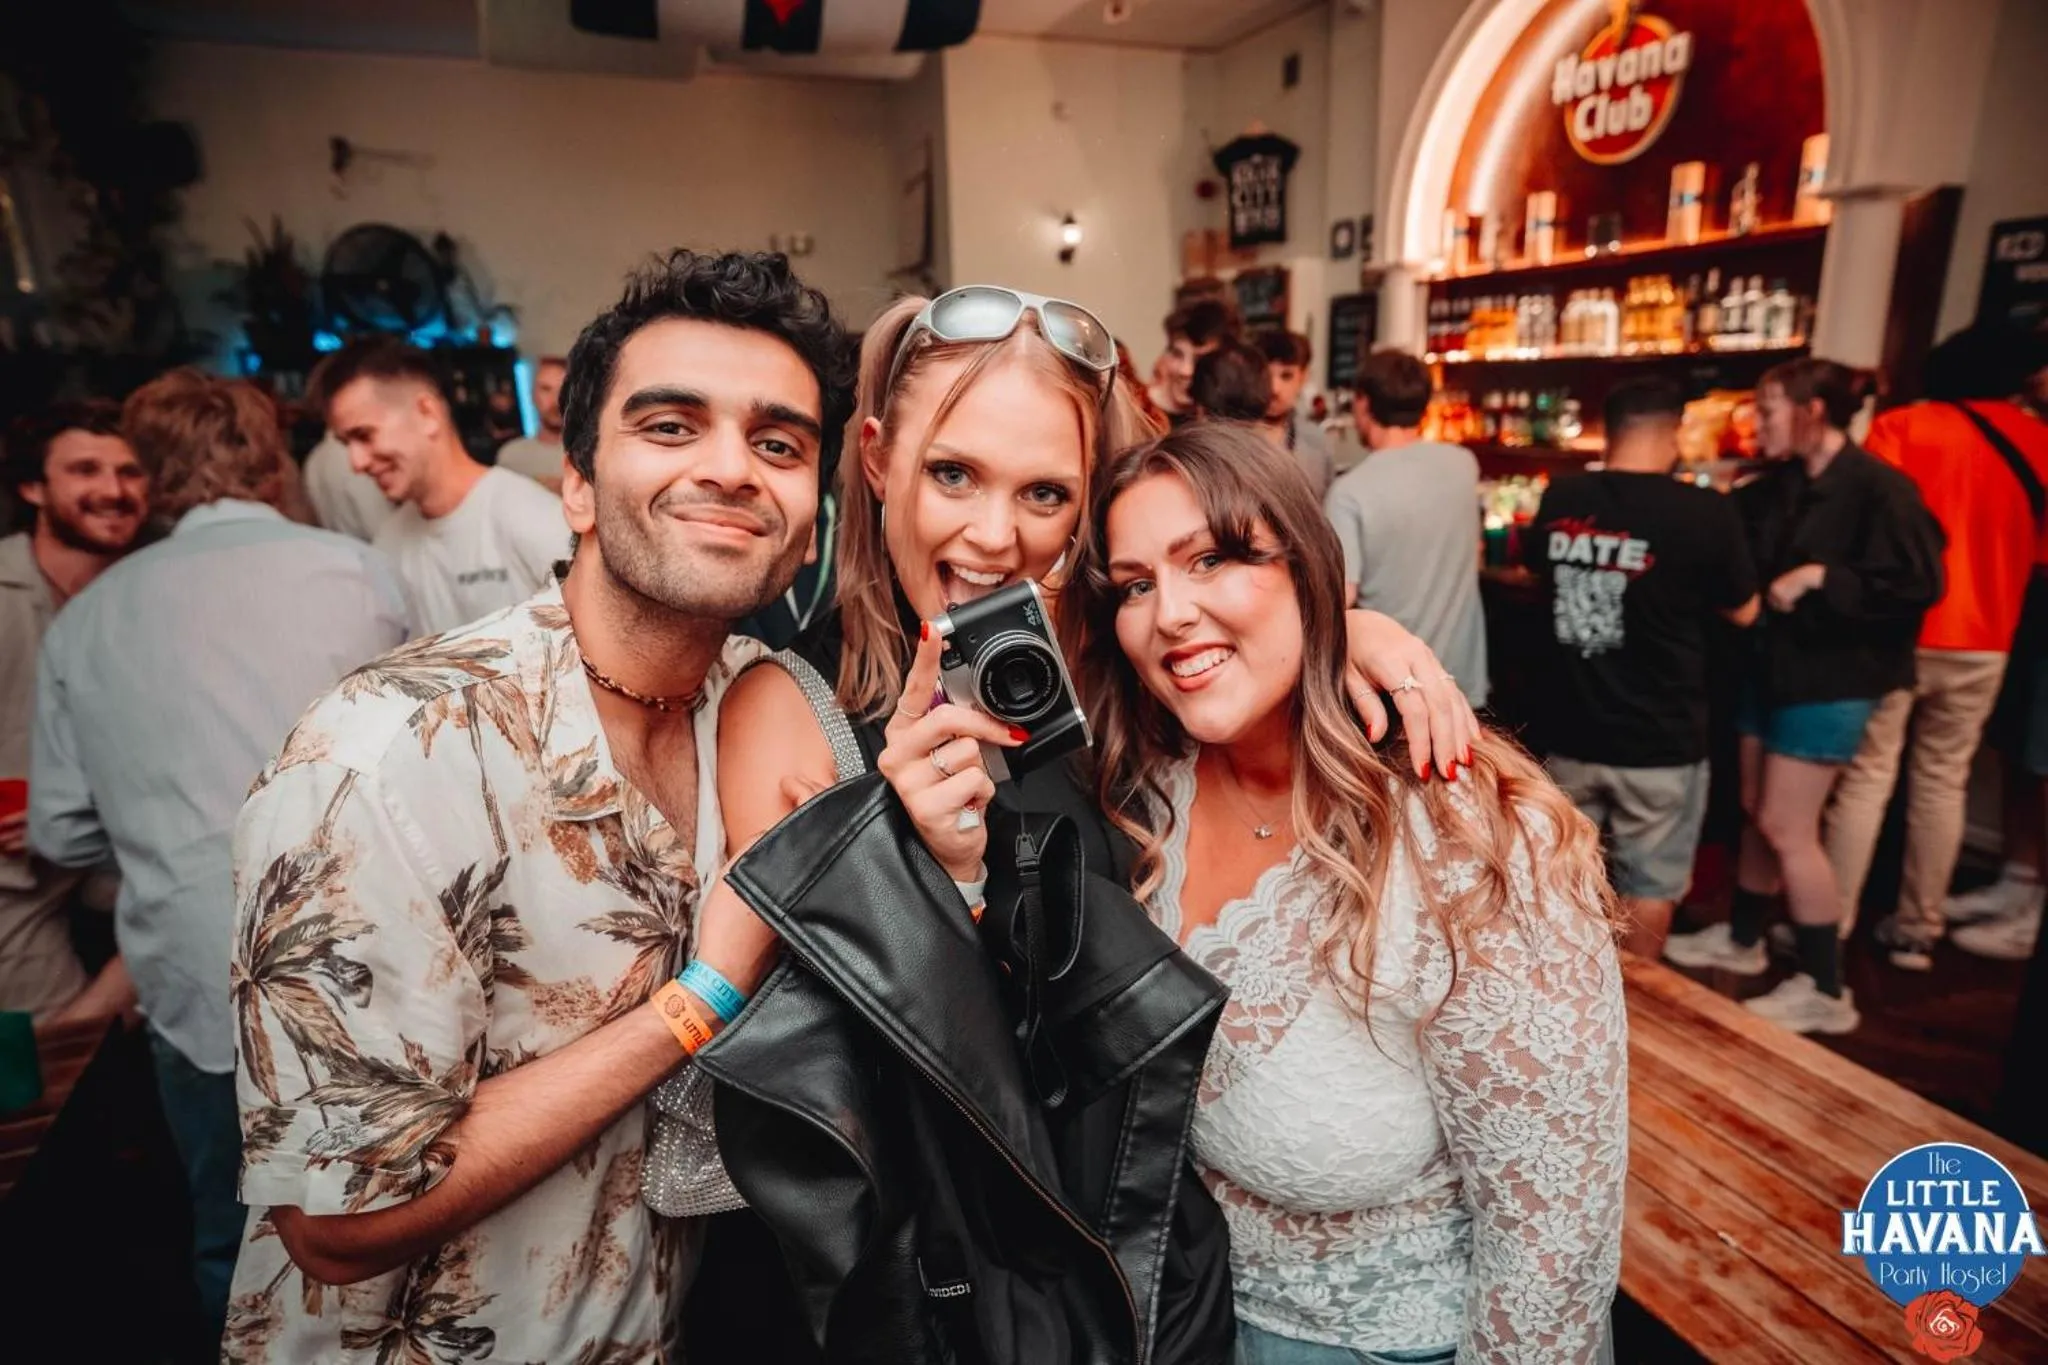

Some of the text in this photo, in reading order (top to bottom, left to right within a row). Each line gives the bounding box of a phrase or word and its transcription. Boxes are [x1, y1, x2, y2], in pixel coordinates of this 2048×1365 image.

[1552, 32, 1692, 105] Havana
[1573, 85, 1654, 141] Club
[1548, 531, 1649, 571] DATE
